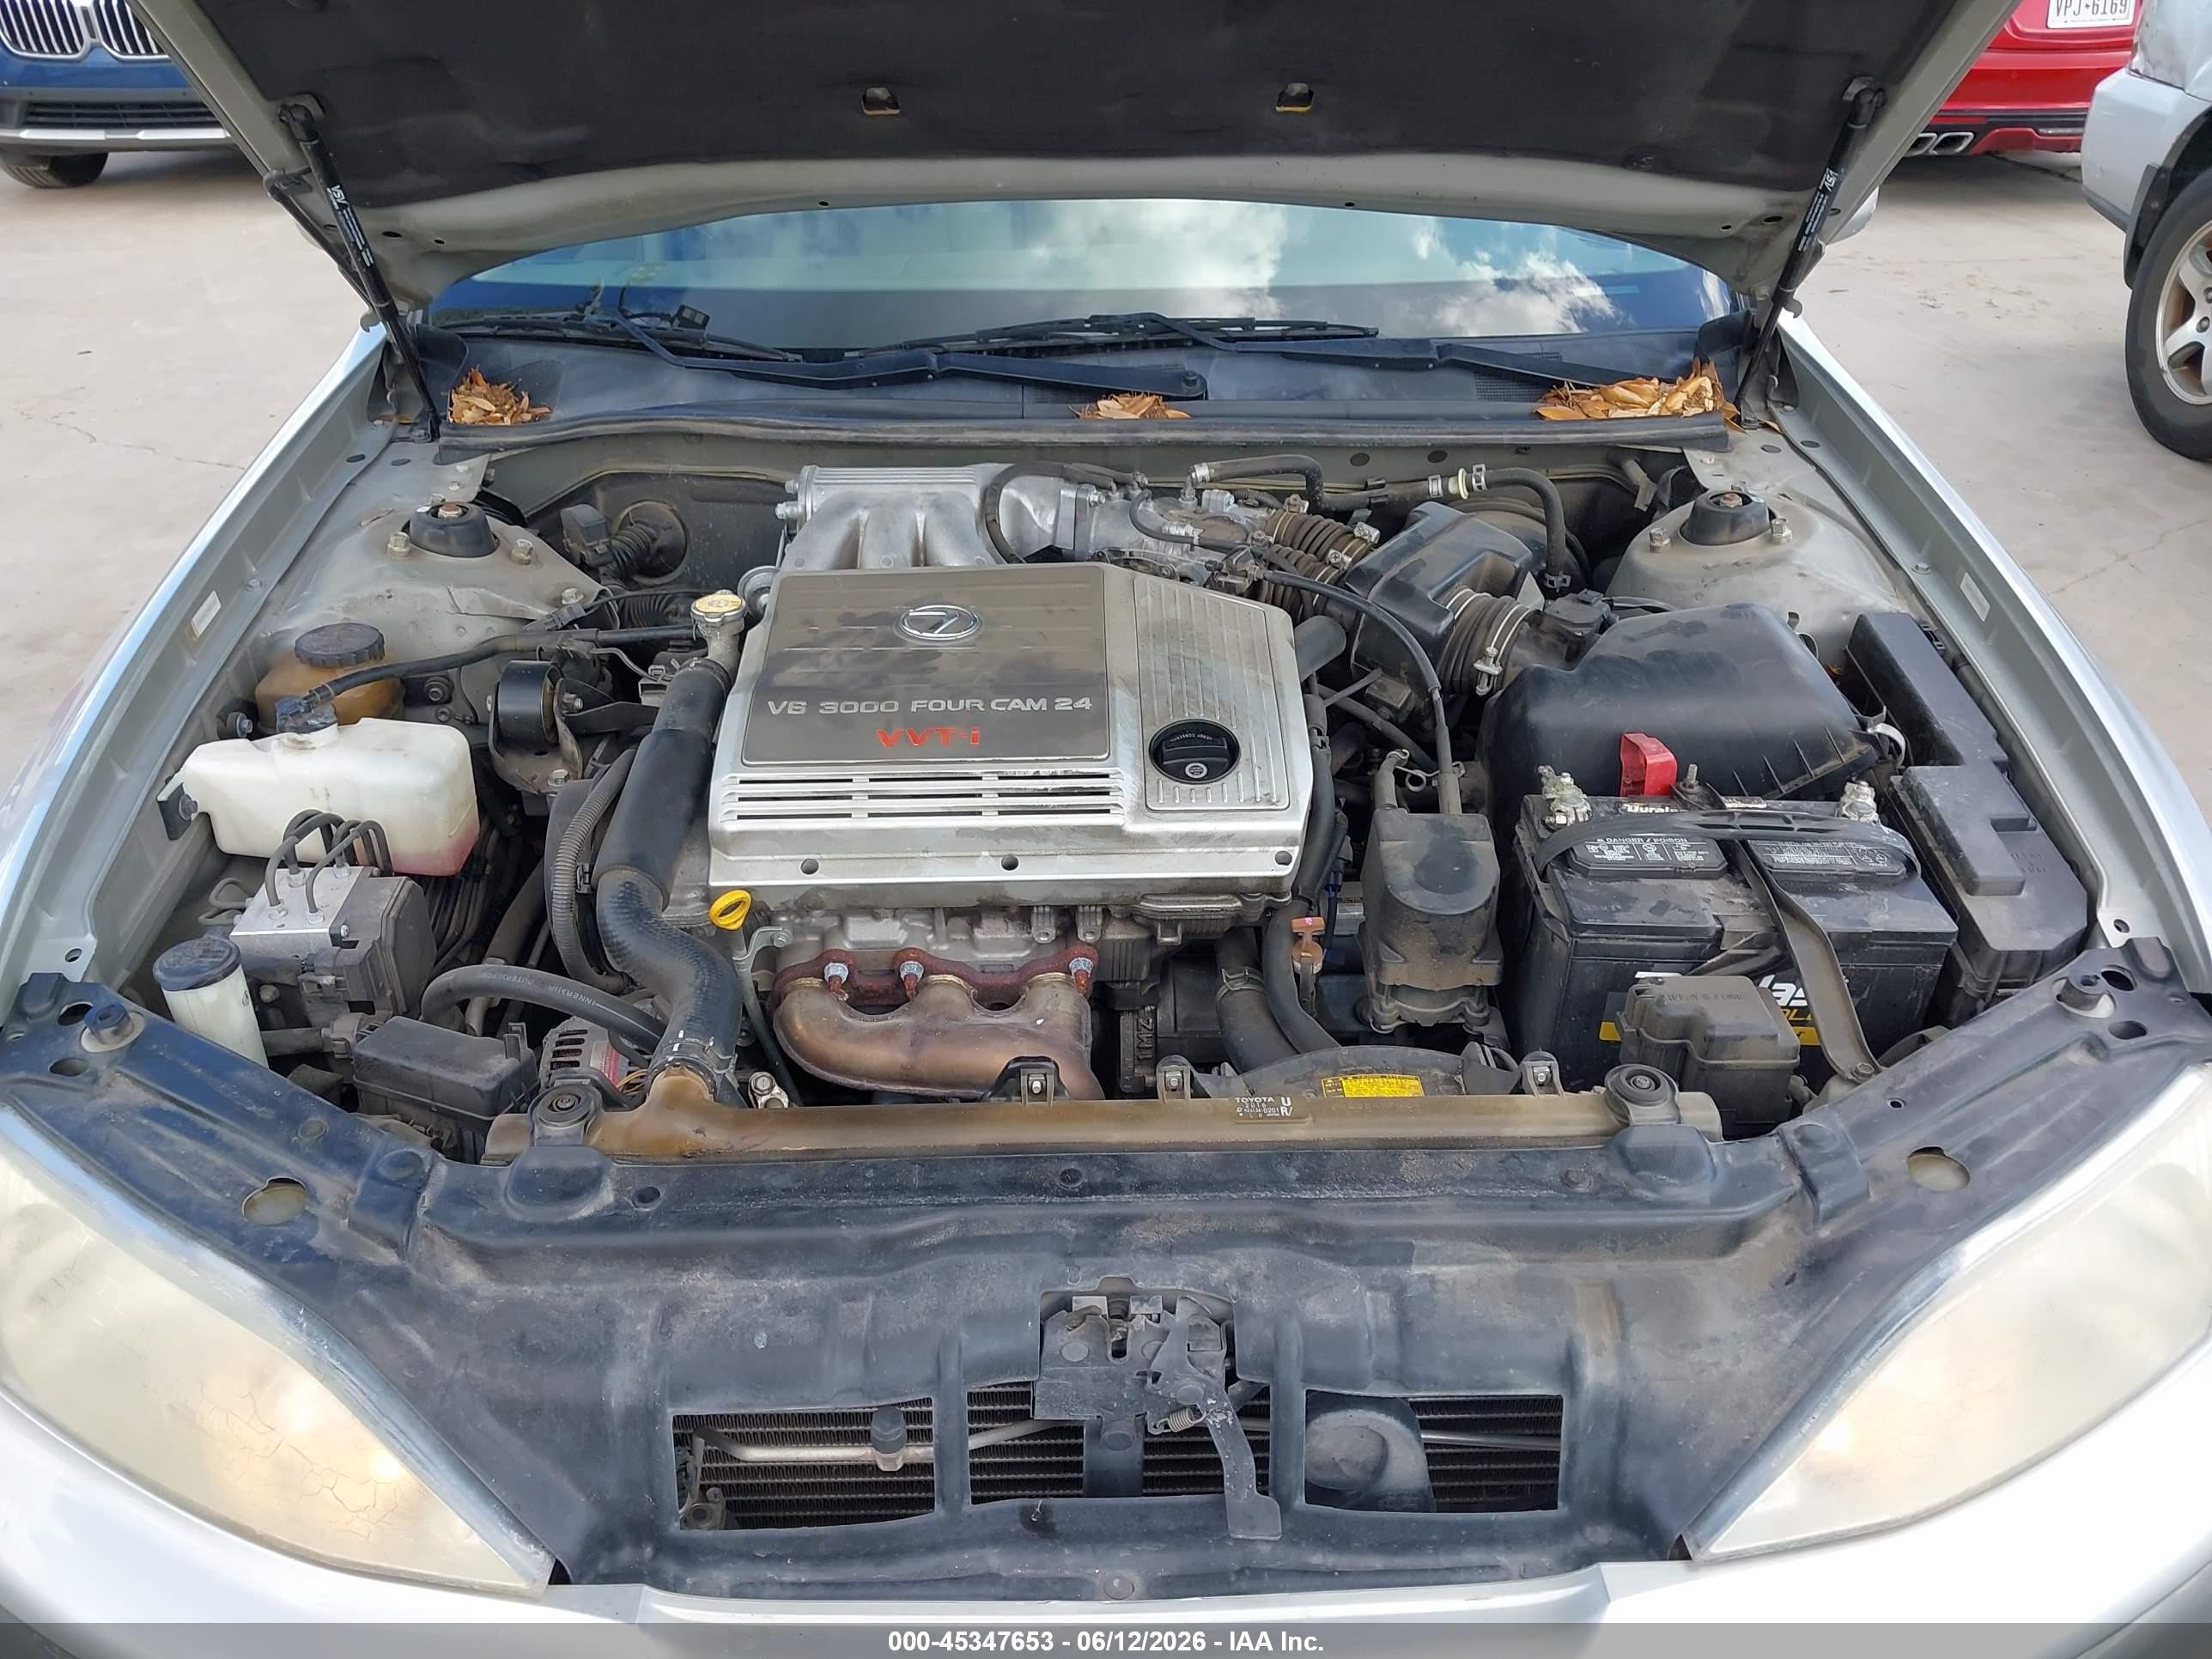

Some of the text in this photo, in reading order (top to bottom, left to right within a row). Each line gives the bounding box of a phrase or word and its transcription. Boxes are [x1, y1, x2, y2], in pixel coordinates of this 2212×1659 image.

[2057, 0, 2128, 16] VPJ 6169
[768, 697, 1092, 714] V6 3000 FOUR CAM 24
[876, 727, 981, 746] VVT-i
